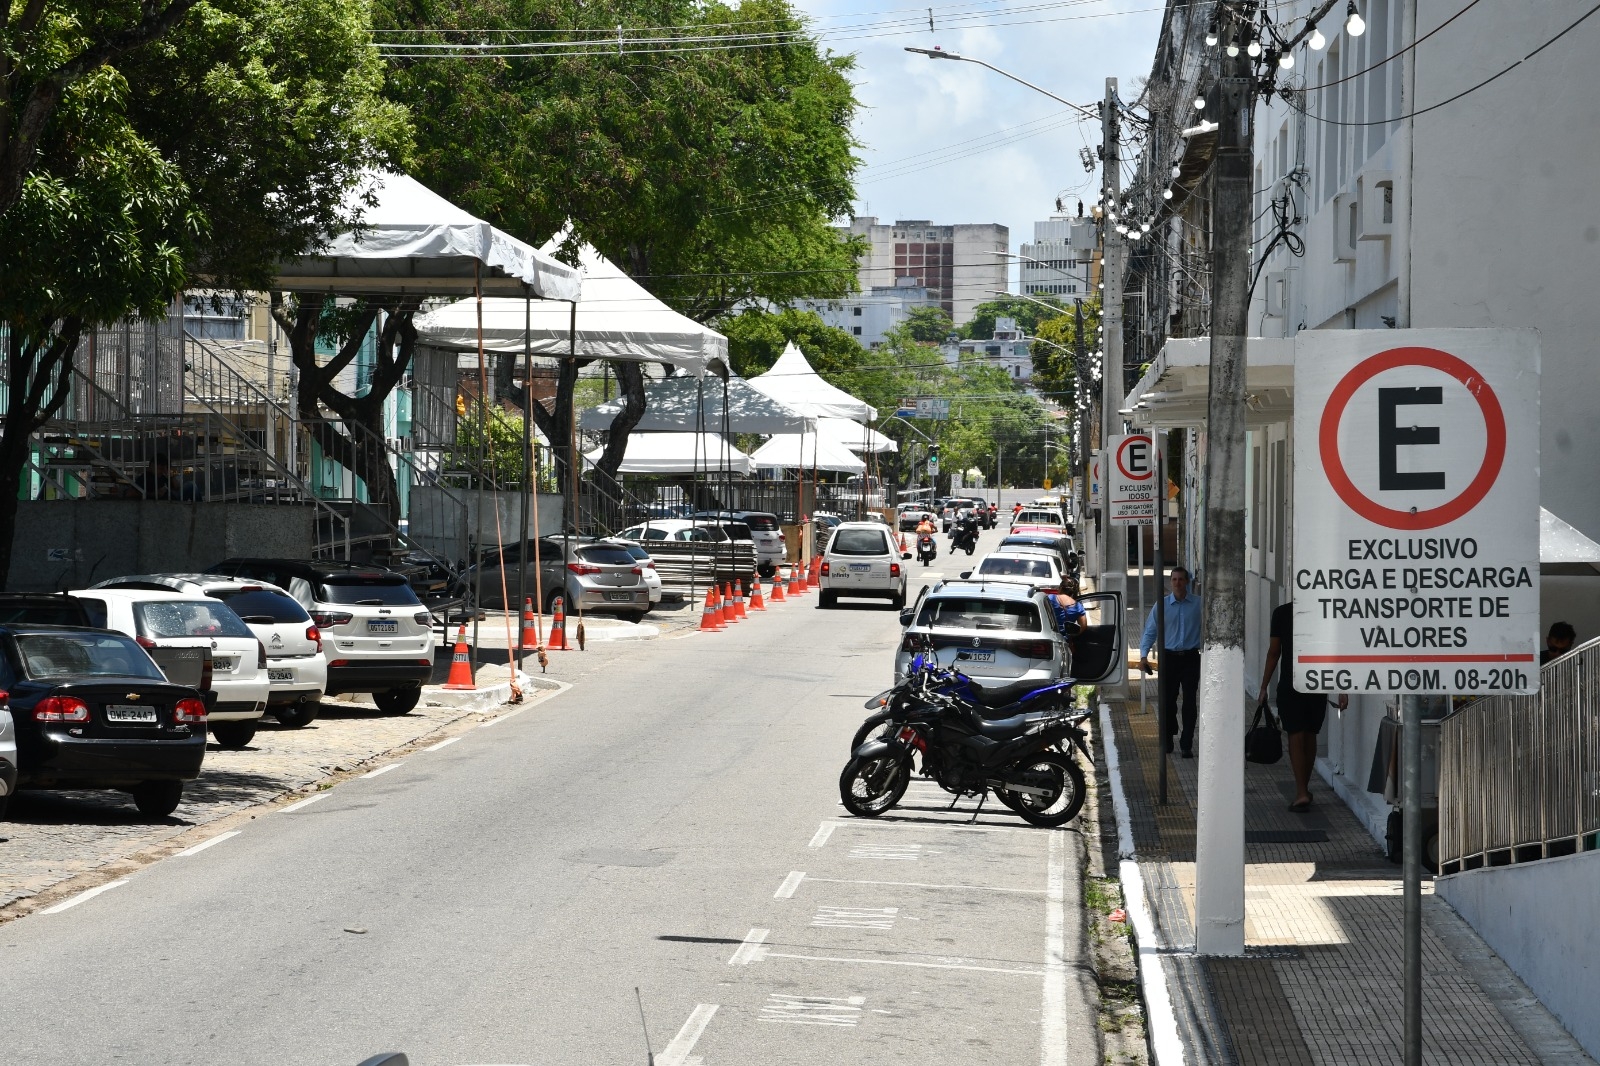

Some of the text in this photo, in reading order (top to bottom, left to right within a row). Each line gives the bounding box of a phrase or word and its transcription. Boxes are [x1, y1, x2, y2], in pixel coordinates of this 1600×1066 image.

[1379, 386, 1446, 491] E
[1129, 444, 1148, 472] E
[1119, 484, 1153, 492] EXCLUSIV
[1349, 537, 1478, 560] EXCLUSIVO
[1296, 566, 1533, 590] CARGA E DESCARGA
[1318, 596, 1510, 619] TRANSPORTE DE
[1360, 625, 1468, 649] VALORES
[1306, 668, 1528, 691] SEG. A DOM. 08-20h
